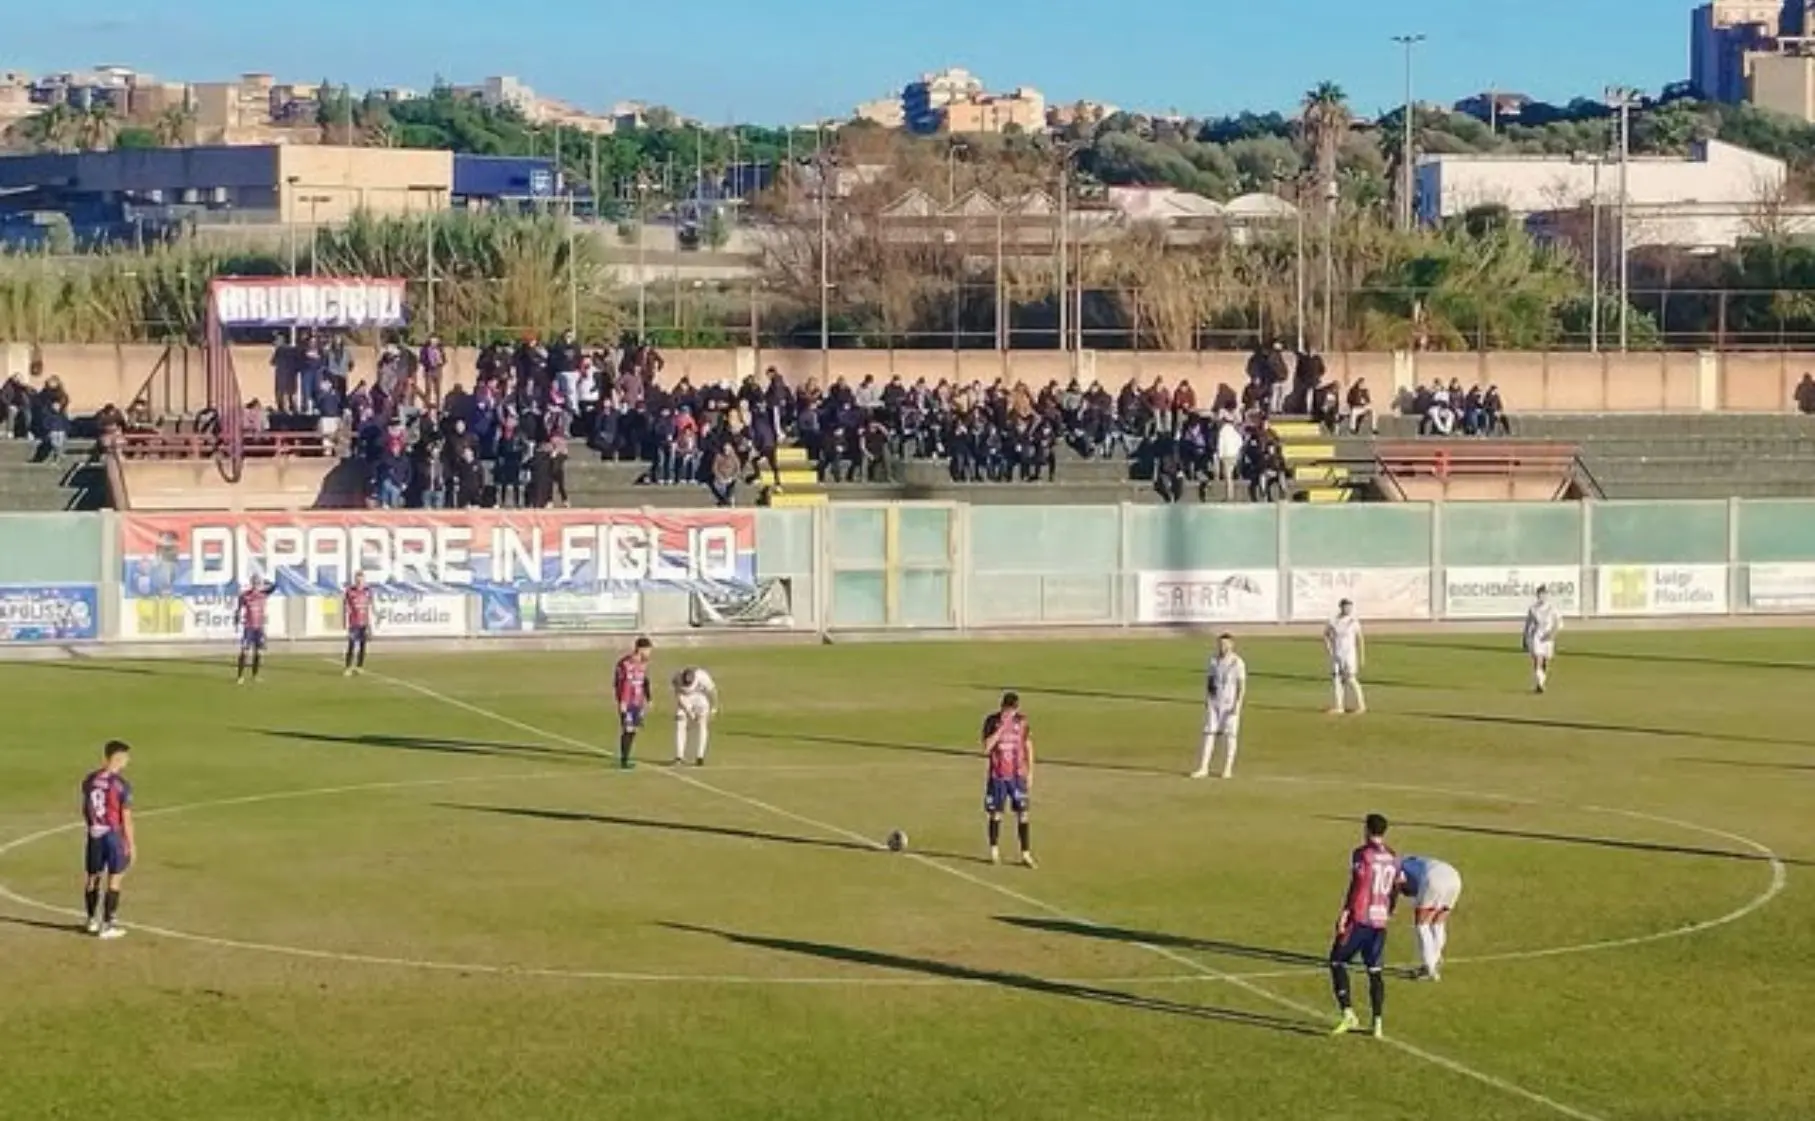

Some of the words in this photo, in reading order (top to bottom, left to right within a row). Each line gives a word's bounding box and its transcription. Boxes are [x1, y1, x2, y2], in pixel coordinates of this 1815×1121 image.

[193, 526, 249, 587] DI
[265, 526, 473, 585] PADRE
[492, 526, 542, 583] IN
[561, 524, 736, 580] FIGLIO
[1371, 863, 1396, 895] 10
